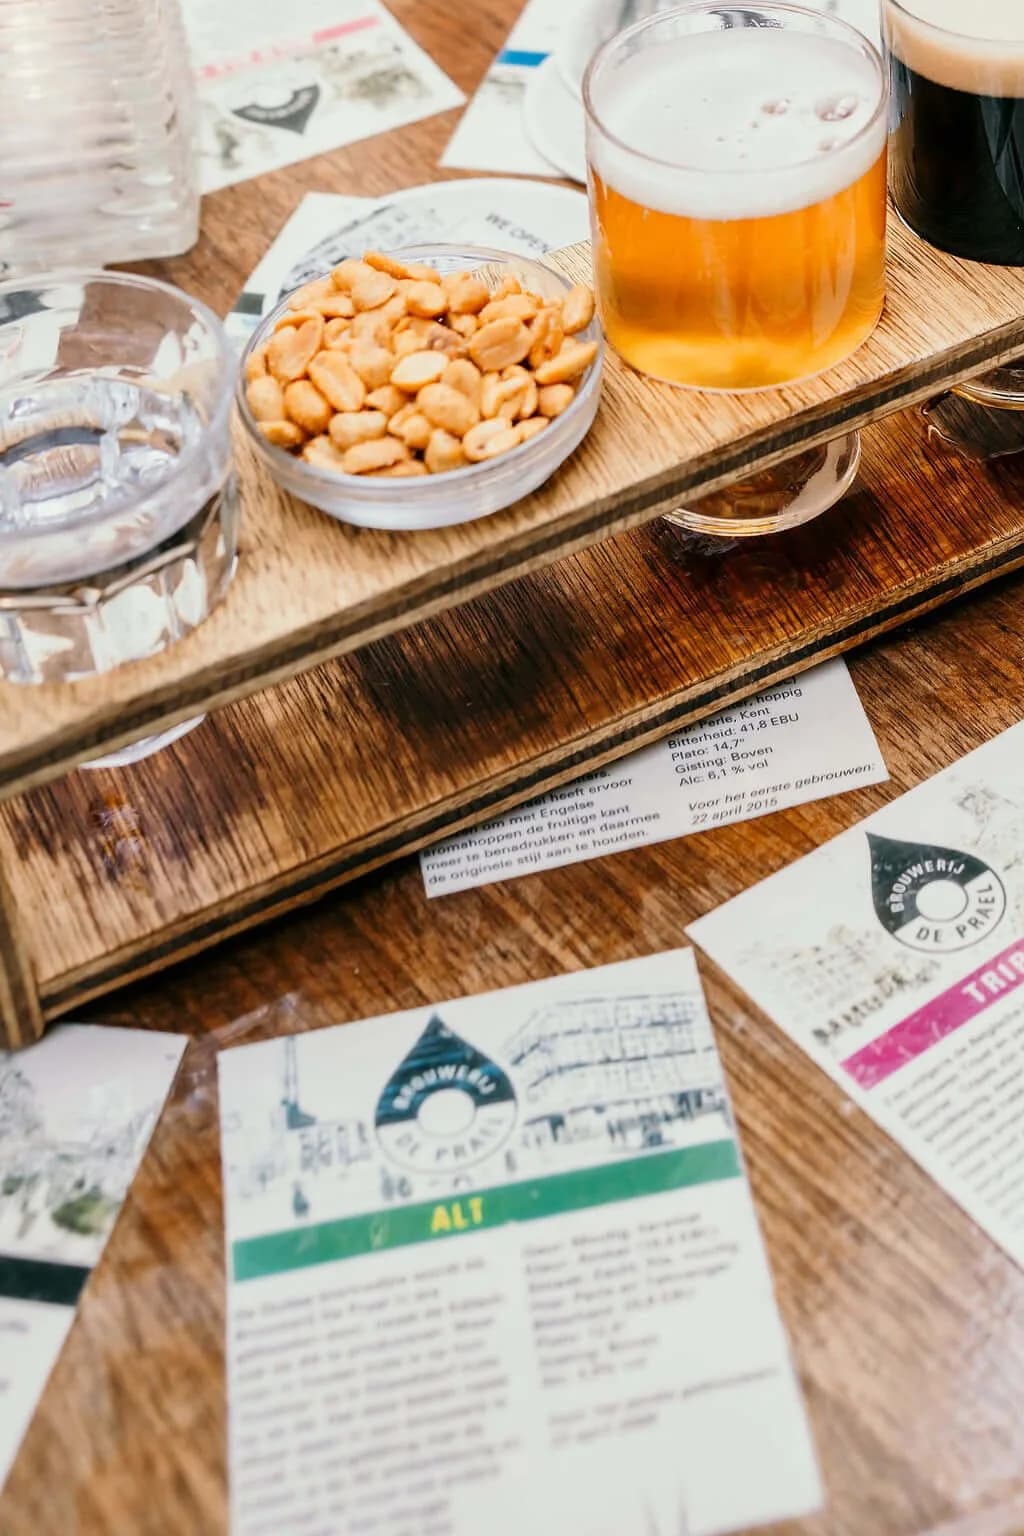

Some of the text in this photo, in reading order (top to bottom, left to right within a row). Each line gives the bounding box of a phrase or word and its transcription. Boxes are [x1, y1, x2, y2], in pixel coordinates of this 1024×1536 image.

[756, 687, 803, 705] hoppig
[740, 707, 770, 720] Kent
[668, 713, 800, 749] Bitterheid: 41,8 EBU
[671, 747, 709, 761] Plato:
[675, 745, 774, 775] Gisting: Boven
[708, 768, 727, 780] 6,1
[732, 766, 744, 774] %
[748, 760, 769, 770] vol
[550, 788, 584, 803] heeft
[589, 777, 633, 793] ervoor
[688, 762, 876, 812] Voor het eerste gebrouwen:
[424, 830, 523, 858] aromahoppen
[526, 823, 543, 835] de
[547, 812, 597, 832] fruitige
[600, 805, 630, 819] kant
[482, 800, 594, 830] om met Engelse
[691, 814, 709, 825] 22
[712, 805, 743, 820] april
[426, 812, 660, 871] meer te benadrukken en daarmee
[428, 830, 649, 885] de originele stijl aan te houden.
[890, 857, 965, 913] BROUWERIJ
[915, 883, 995, 944] DE PRAEL
[431, 1197, 484, 1233] ALT
